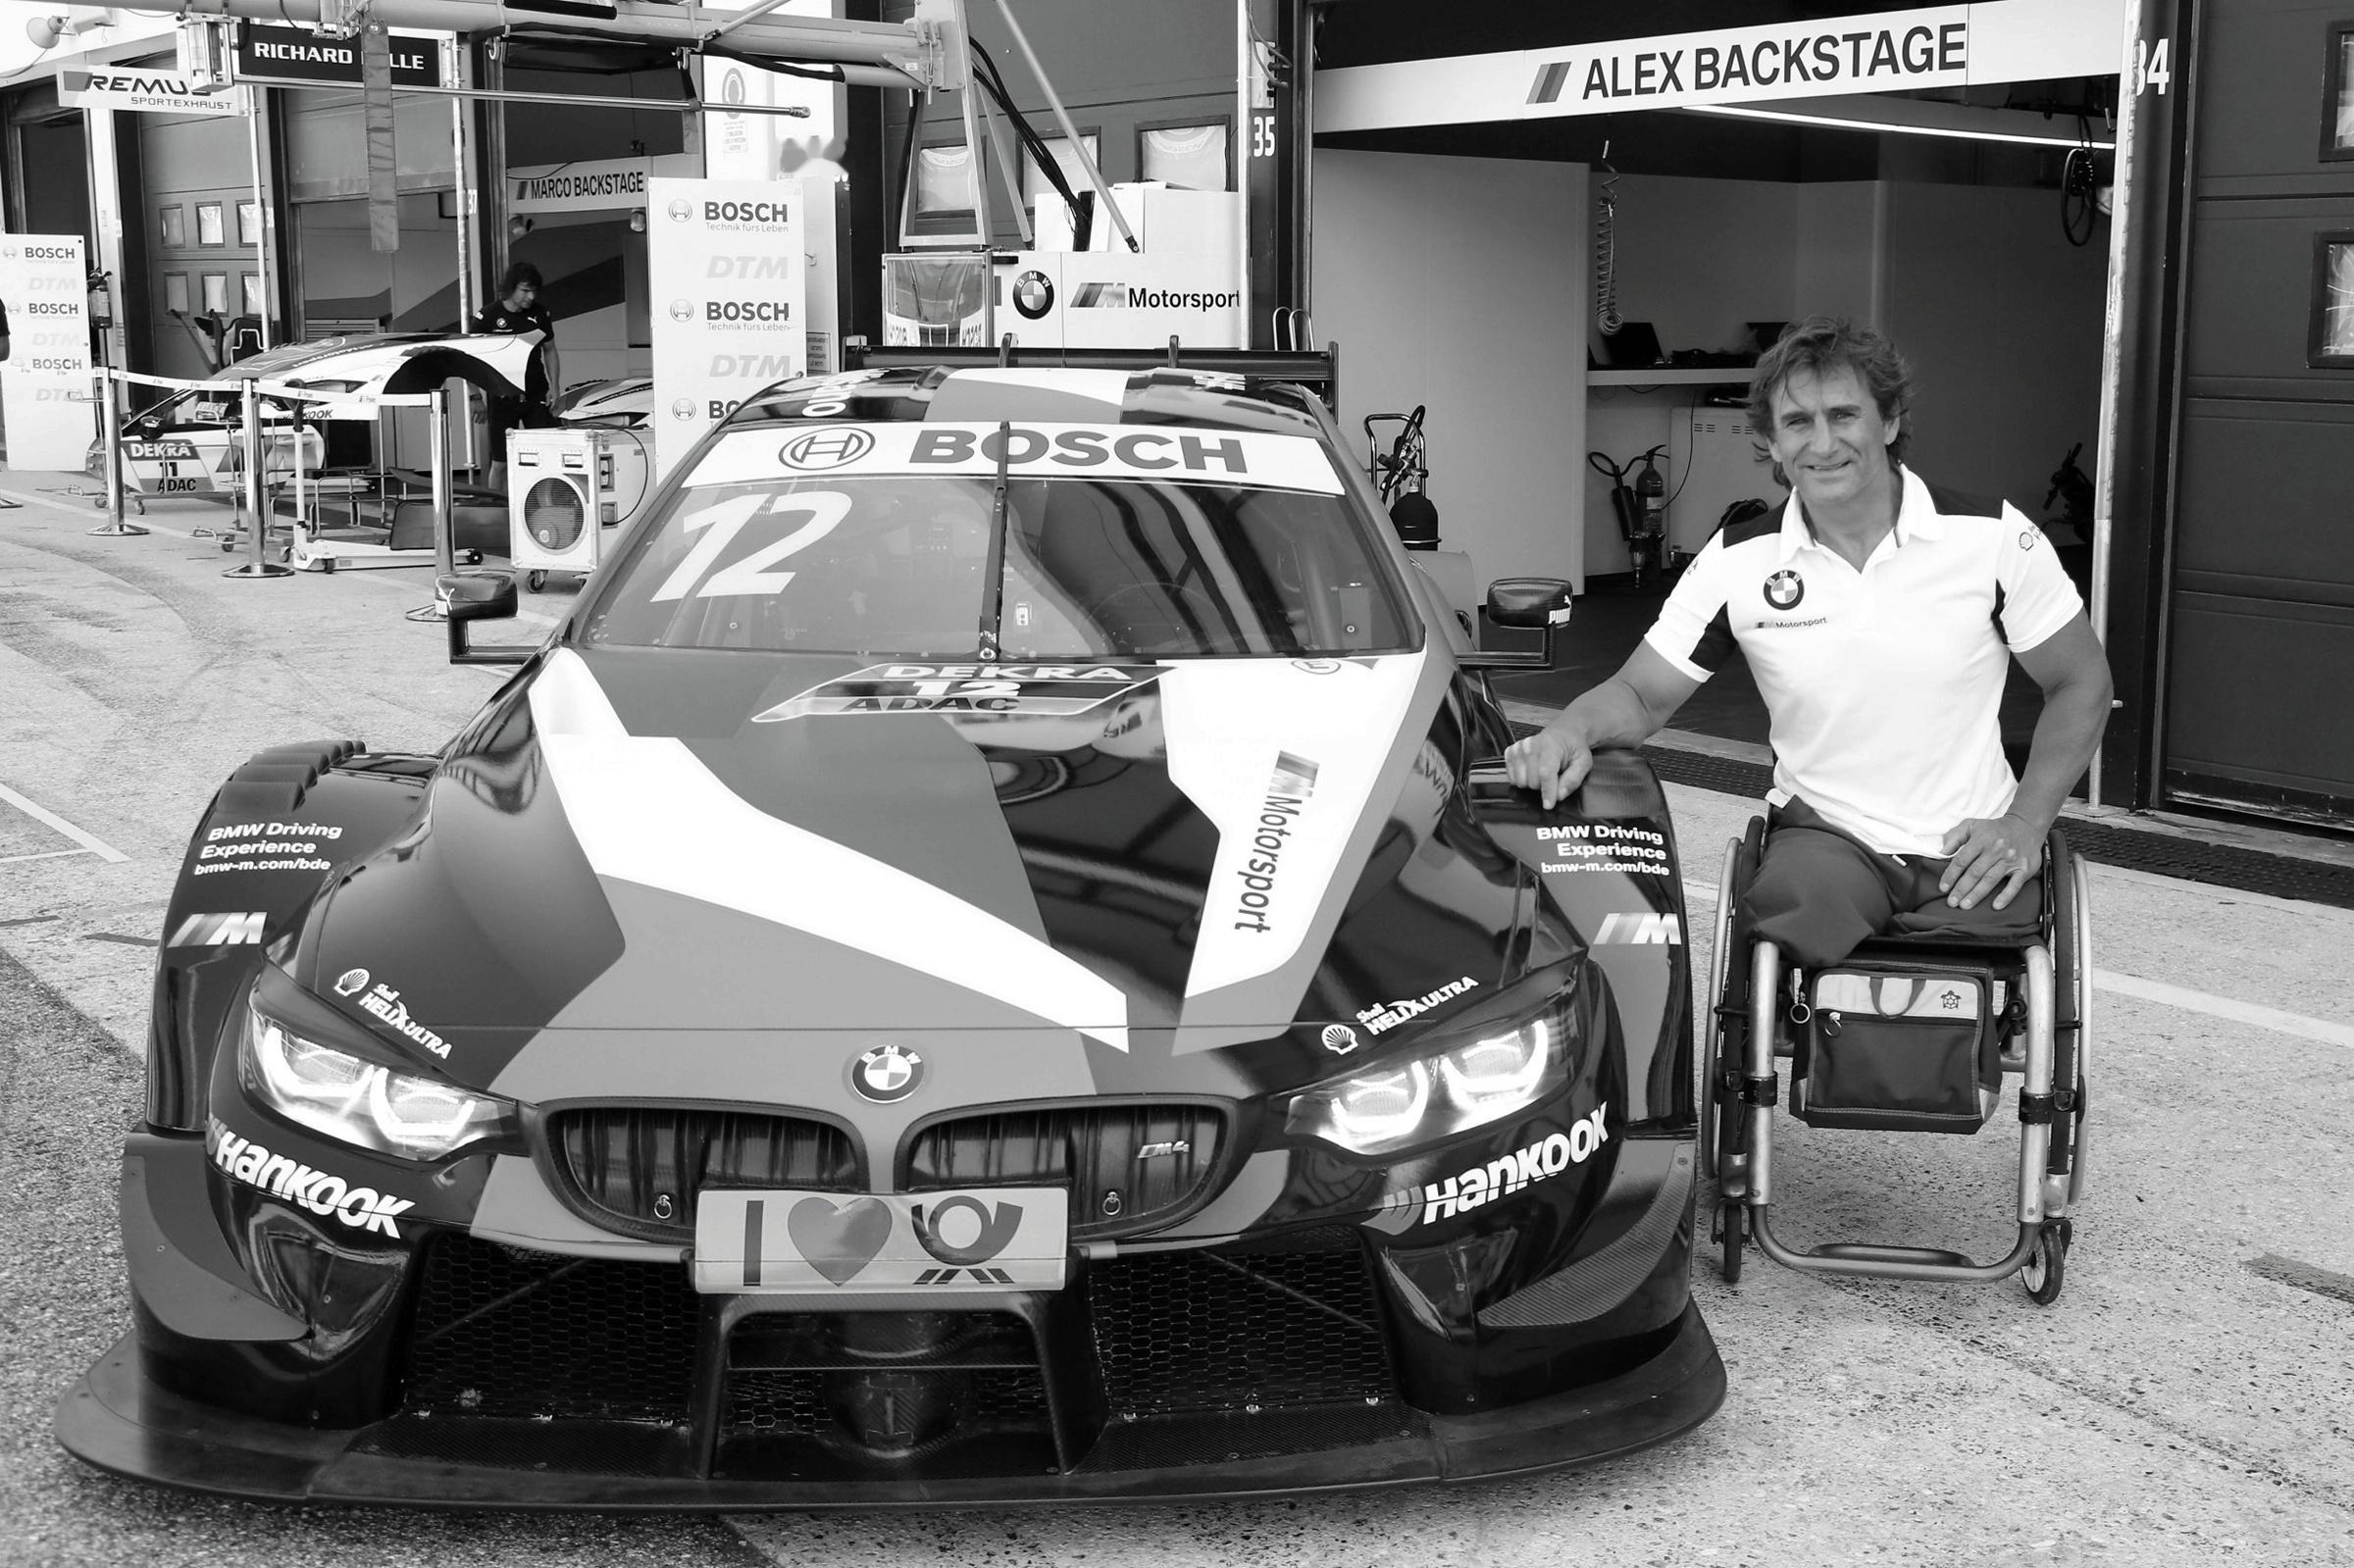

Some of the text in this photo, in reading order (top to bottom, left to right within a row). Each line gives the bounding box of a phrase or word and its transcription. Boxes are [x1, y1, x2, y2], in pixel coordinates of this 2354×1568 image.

[253, 42, 353, 65] RICHARD
[1582, 23, 1966, 100] ALEX BACKSTAGE
[85, 75, 212, 97] REMU
[130, 97, 232, 110] SPORTEXHAUST
[1254, 116, 1275, 157] 35
[531, 172, 643, 199] MARCO BACKSTAGE
[704, 201, 788, 223] BOSCH
[706, 222, 789, 232] Technik fürs Leben
[25, 247, 76, 259] BOSCH
[706, 255, 789, 279] DTM
[28, 277, 77, 291] DTM
[28, 303, 78, 315] BOSCH
[1129, 287, 1240, 312] Motorsport
[706, 301, 790, 321] BOSCH
[707, 322, 742, 331] Technik
[32, 333, 80, 346] DTM
[32, 359, 82, 370] BOSCH
[709, 354, 791, 378] DTM
[130, 442, 191, 457] DEKRA
[909, 429, 1248, 474] BOSCH
[159, 462, 178, 477] 11
[157, 479, 196, 492] ADAC
[649, 490, 852, 603] 12
[1775, 617, 1827, 629] Motorsport
[883, 666, 1133, 681] DEKRA
[912, 681, 1021, 696] 12
[839, 697, 1021, 713] ADAC
[207, 822, 342, 841] BMW Driving
[1536, 825, 1663, 845] BMW Driving
[200, 840, 317, 859] Experience
[1557, 842, 1666, 860] Experience
[194, 858, 332, 876] bmw-m.com/bde
[1234, 795, 1303, 933] Motorsport
[1541, 861, 1669, 876] bmw-m.com/bde
[1421, 976, 1479, 1007] ULTRA
[403, 1021, 452, 1059] ULTRA
[742, 1200, 765, 1287] I
